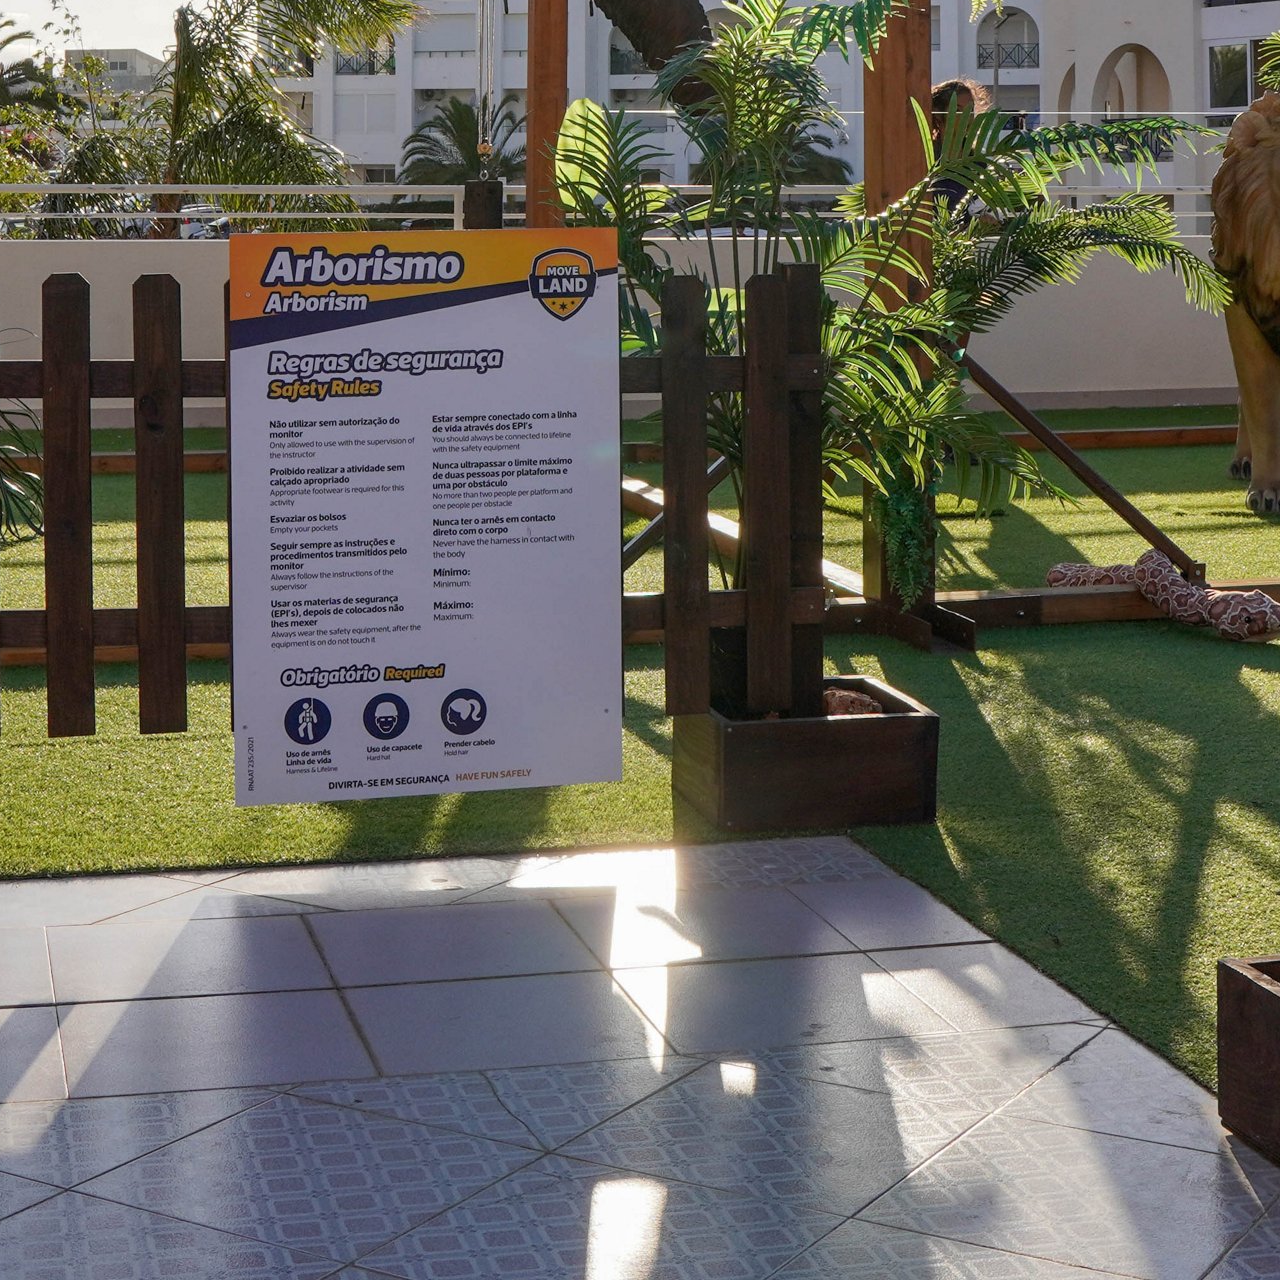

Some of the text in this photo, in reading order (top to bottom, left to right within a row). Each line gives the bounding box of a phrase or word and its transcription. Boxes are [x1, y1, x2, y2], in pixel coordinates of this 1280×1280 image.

[265, 247, 460, 285] Arborismo
[547, 267, 579, 275] MOVE
[539, 278, 587, 293] LAND
[265, 292, 367, 313] Arborism
[268, 348, 504, 378] Regras de segurança
[268, 377, 382, 402] Safety Rules
[270, 420, 286, 428] Não
[289, 420, 316, 428] utilizar
[339, 418, 387, 426] autorização
[455, 415, 486, 423] sempre
[488, 413, 530, 421] conectado
[445, 424, 462, 432] vida
[464, 423, 494, 431] através
[287, 440, 314, 448] allowed
[461, 444, 482, 452] safety
[347, 465, 385, 473] atividade
[460, 460, 506, 469] ultrapassar
[445, 471, 464, 479] duas
[466, 470, 500, 479] pessoas
[502, 470, 514, 478] por
[517, 468, 561, 477] plataforma
[270, 476, 349, 487] calçado apropriado
[453, 482, 466, 490] por
[468, 479, 507, 488] obstáculo
[270, 489, 310, 497] Appropriate
[352, 486, 380, 494] required
[270, 499, 294, 507] activity
[271, 515, 305, 523] Esvaziar
[319, 513, 346, 521] bolsos
[481, 516, 504, 524] arnês
[521, 514, 556, 522] contacto
[485, 526, 508, 535] corpo
[271, 542, 298, 552] Seguir
[345, 538, 388, 547] instruções
[490, 537, 520, 545] harness
[271, 548, 407, 561] procedimentos transmitidos pelo
[447, 550, 465, 559] body
[297, 572, 318, 580] follow
[333, 570, 372, 578] instructions
[433, 568, 470, 577] Mínimo:
[271, 600, 290, 608] Usar
[304, 598, 341, 606] materias
[355, 595, 398, 605] segurança
[434, 601, 473, 610] Máximo:
[303, 608, 331, 617] depois
[346, 606, 387, 614] colocados
[271, 620, 289, 628] lhes
[281, 663, 446, 688] Obrigatório Required
[392, 743, 422, 752] capacete
[444, 738, 495, 748] Prender cabelo
[286, 758, 305, 766] Linha
[456, 769, 531, 781] HAVE FUN SAFELY
[329, 780, 378, 789] DIVIRTA-SE
[396, 774, 449, 785] SEGURANÇA
